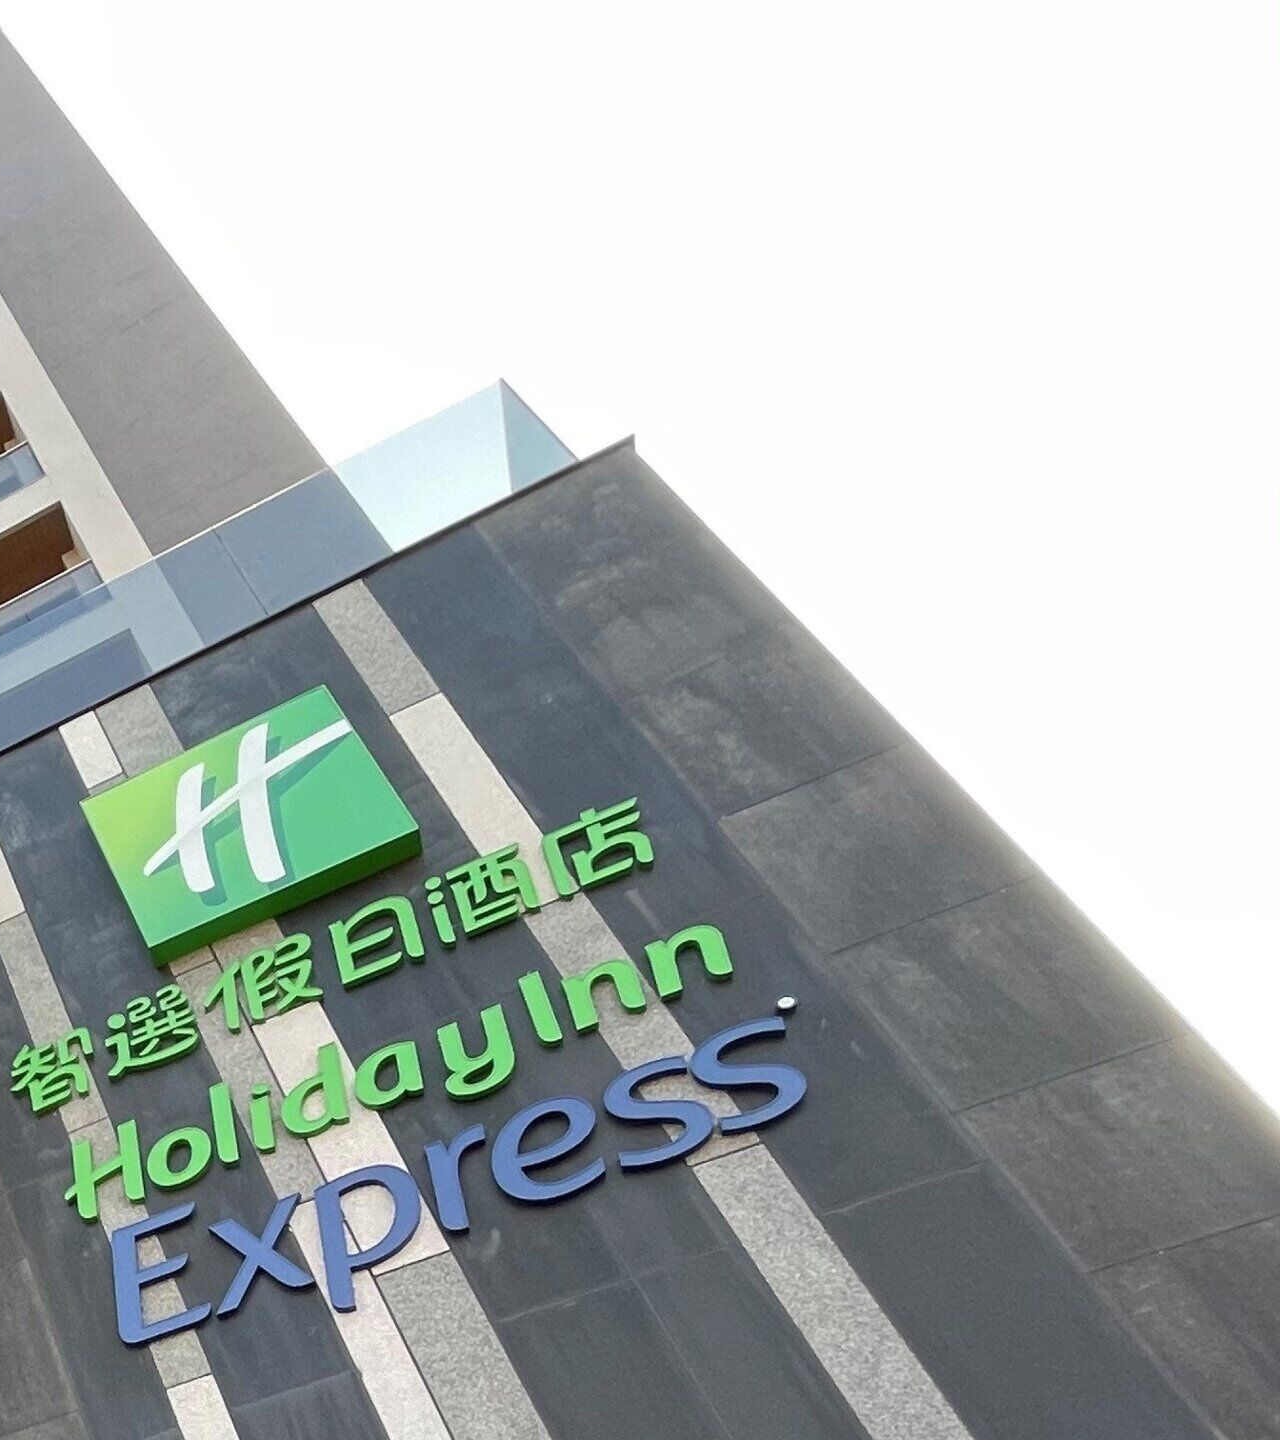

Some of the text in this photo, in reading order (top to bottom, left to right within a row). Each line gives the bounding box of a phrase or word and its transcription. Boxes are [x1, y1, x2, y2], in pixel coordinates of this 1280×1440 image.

[11, 797, 653, 1114] 智選假日酒店
[64, 923, 734, 1220] Holiday Inn
[112, 1014, 807, 1344] Express
